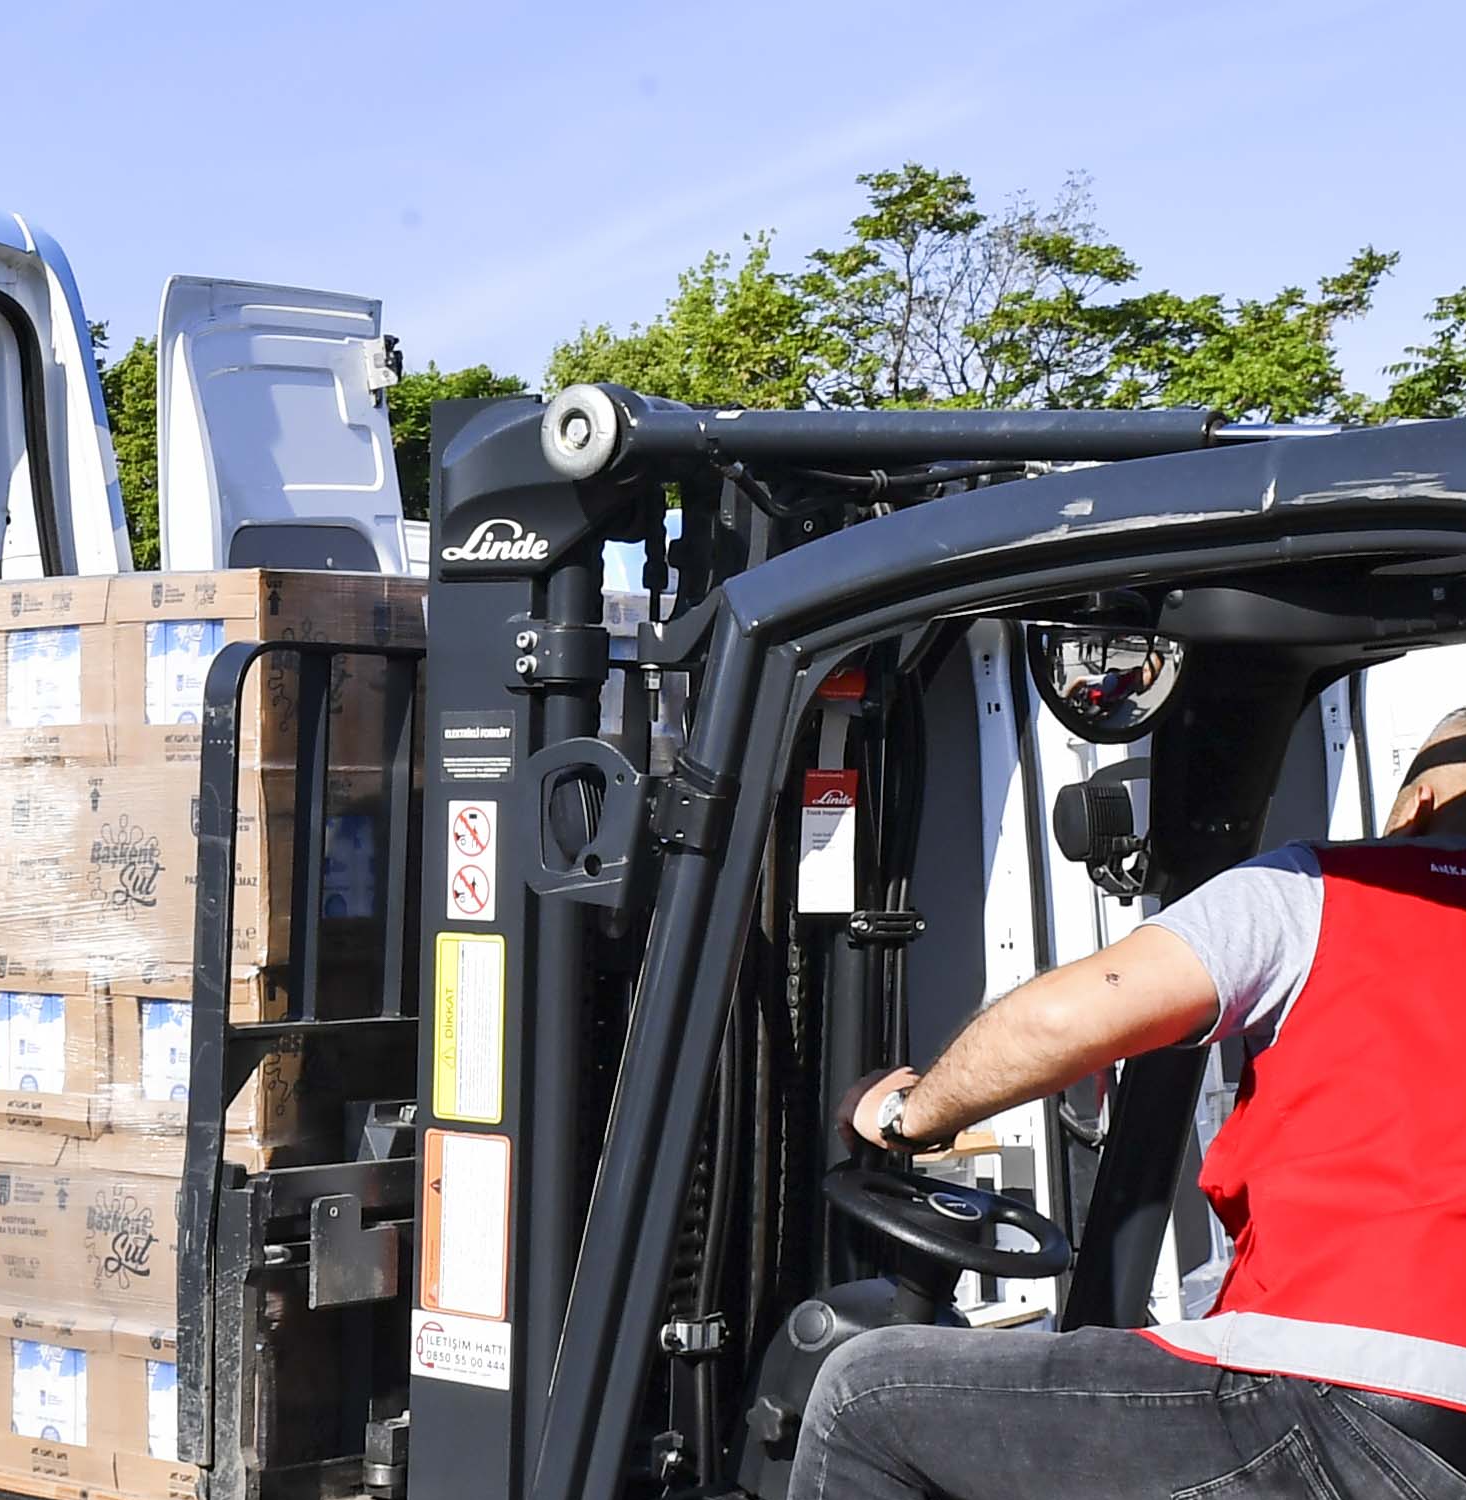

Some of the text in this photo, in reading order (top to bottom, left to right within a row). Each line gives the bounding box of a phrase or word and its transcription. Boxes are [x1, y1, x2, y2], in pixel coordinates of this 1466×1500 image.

[441, 518, 549, 560] Linde
[812, 789, 853, 806] Linde
[426, 1333, 507, 1357] İLETİŞİM HATTI
[426, 1350, 451, 1364] 0850
[455, 1354, 467, 1366] 55
[470, 1357, 483, 1368] 00
[487, 1359, 506, 1372] 444
